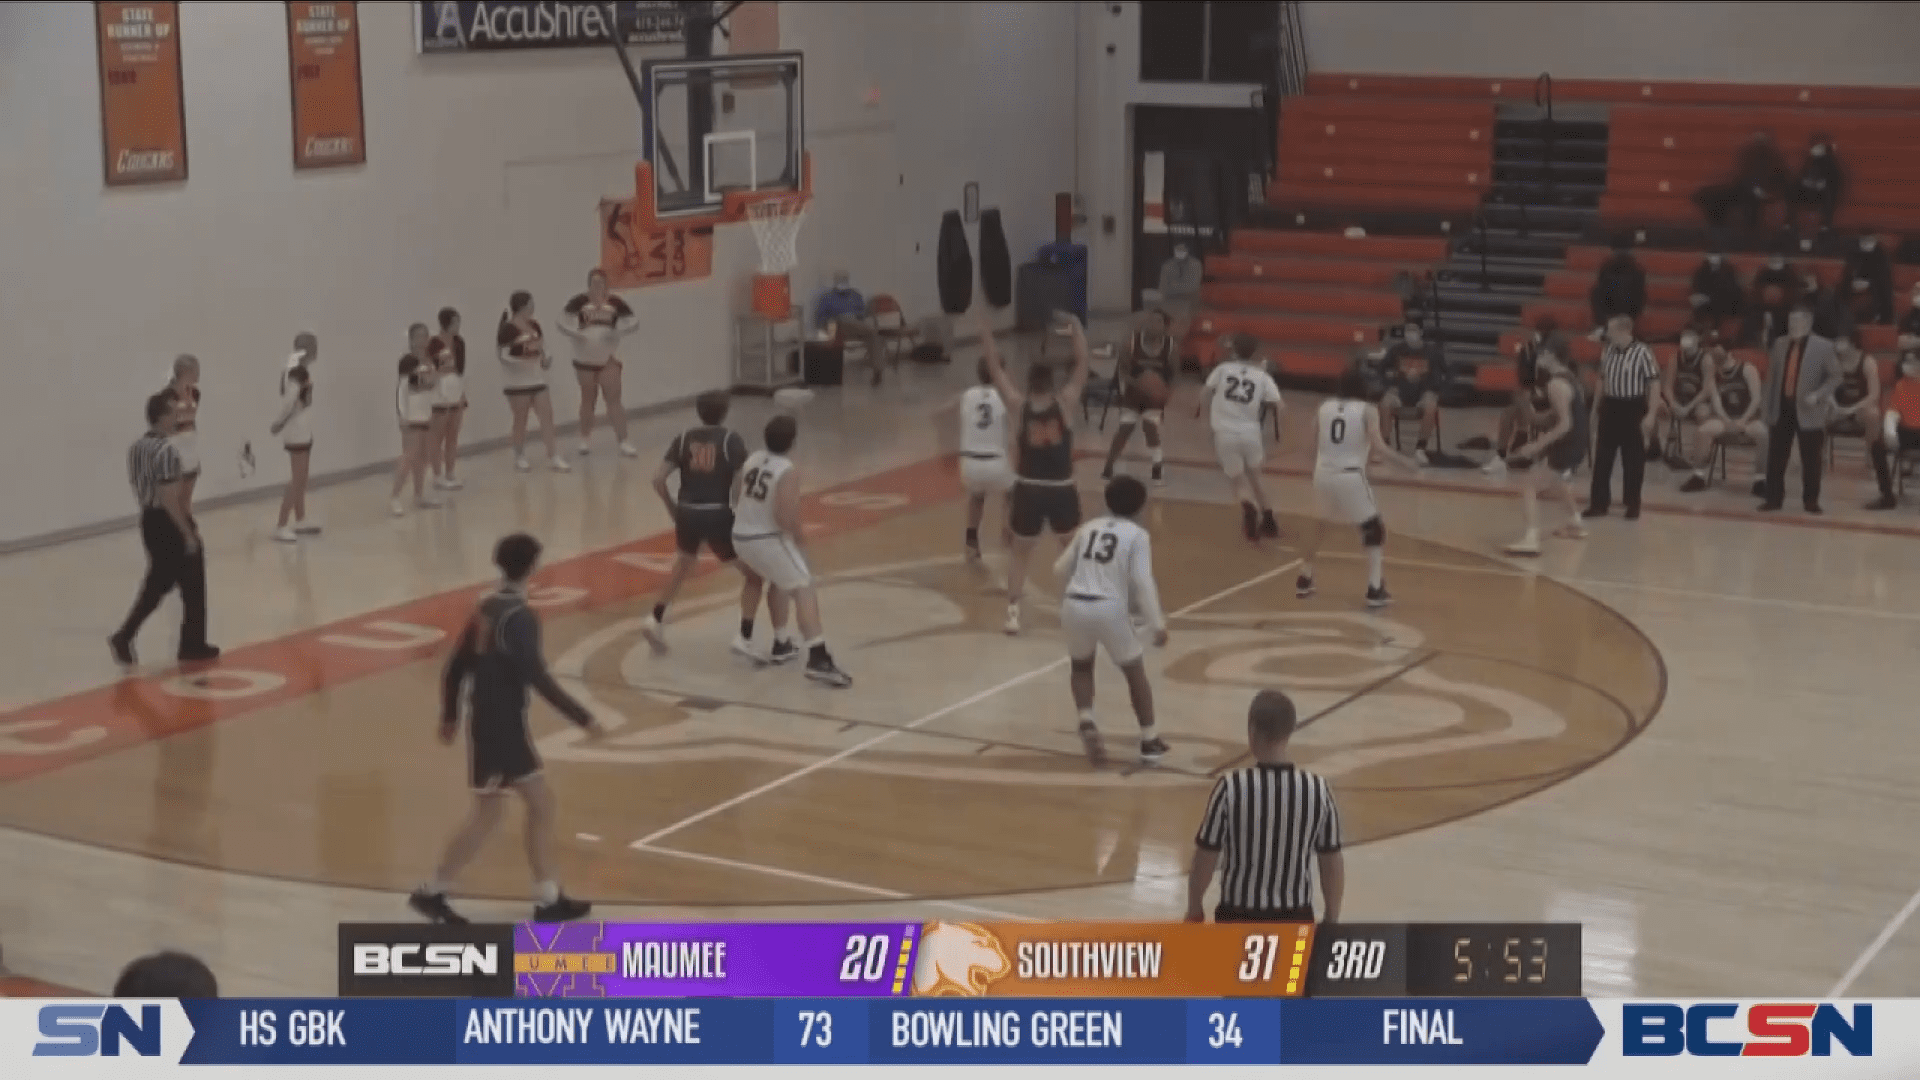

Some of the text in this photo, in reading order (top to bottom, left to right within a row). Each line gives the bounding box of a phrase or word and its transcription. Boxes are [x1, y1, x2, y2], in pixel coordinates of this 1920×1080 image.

[1223, 375, 1256, 404] 23
[975, 403, 994, 430] 3
[1330, 418, 1347, 444] 0
[743, 467, 773, 502] 45
[1082, 530, 1118, 564] 13
